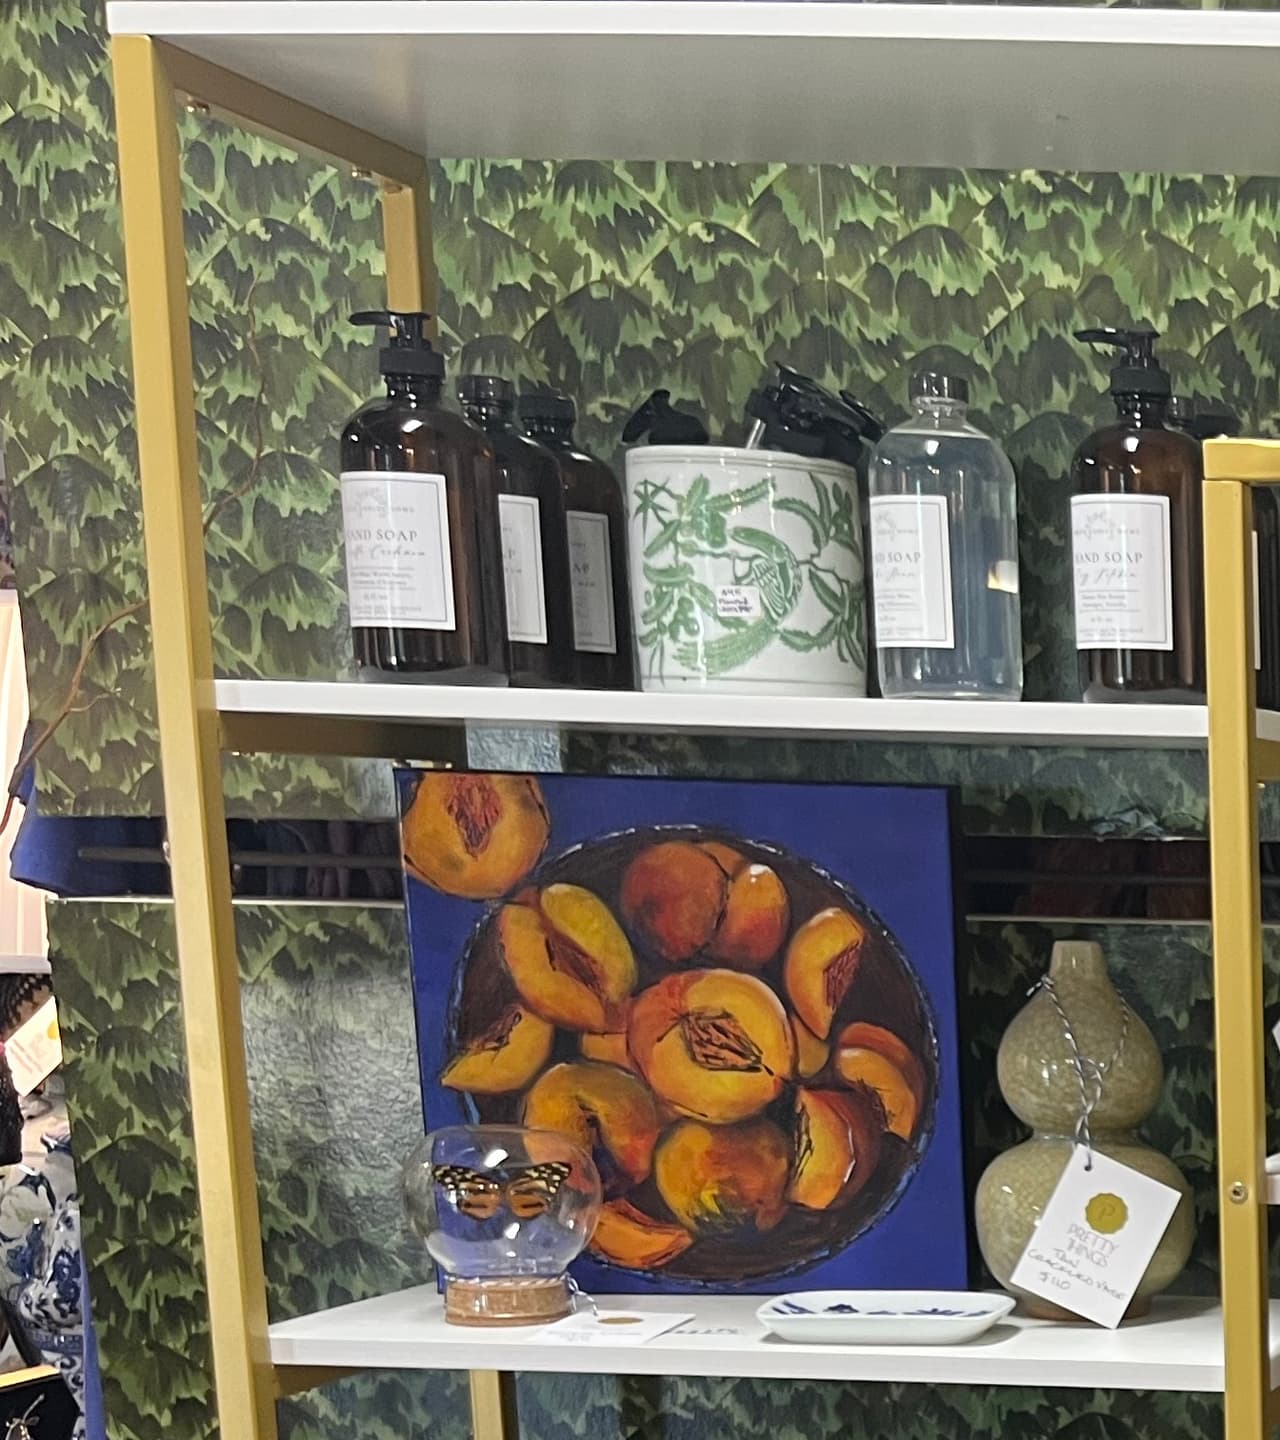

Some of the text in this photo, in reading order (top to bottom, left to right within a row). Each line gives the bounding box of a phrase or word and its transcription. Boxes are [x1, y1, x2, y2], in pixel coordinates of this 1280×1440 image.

[376, 529, 418, 542] SOAP
[888, 551, 921, 563] SOAP
[1104, 551, 1143, 564] SOAP
[1067, 1223, 1120, 1255] PRETTY
